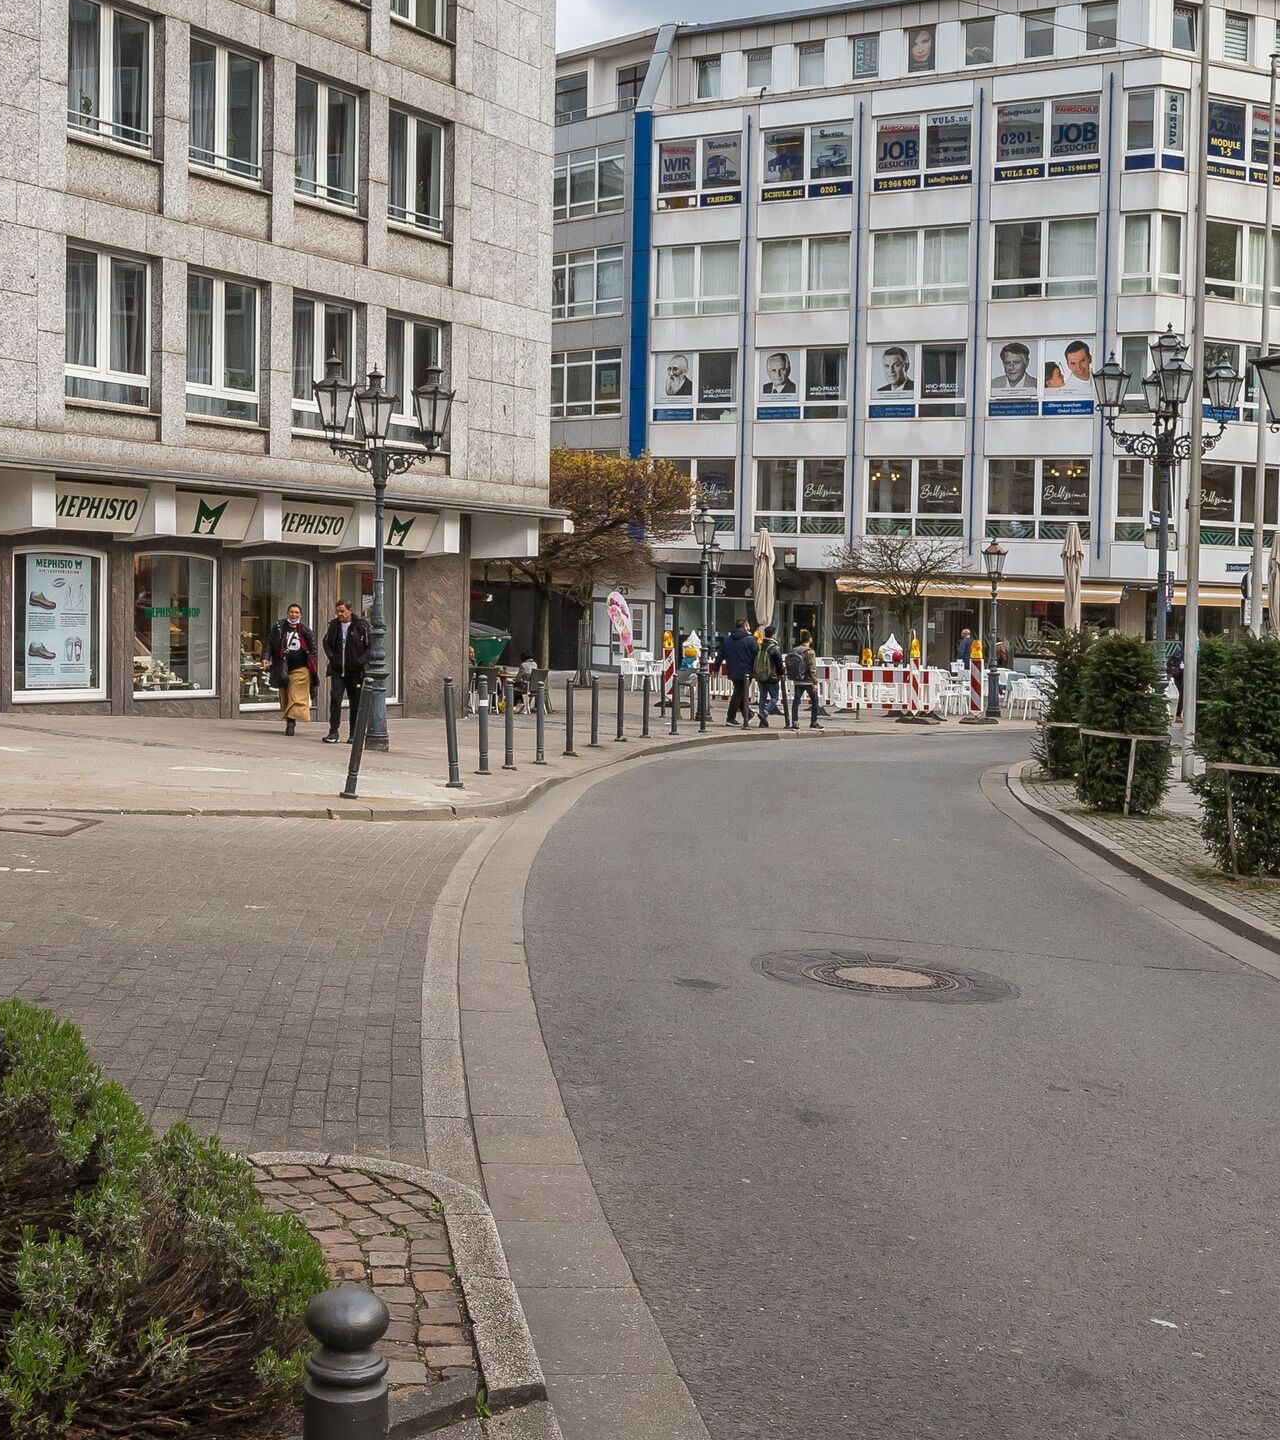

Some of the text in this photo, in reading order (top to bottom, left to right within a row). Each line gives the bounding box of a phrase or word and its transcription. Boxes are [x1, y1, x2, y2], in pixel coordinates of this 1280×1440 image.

[1169, 95, 1178, 145] VULS.DE
[1053, 122, 1097, 145] JOB
[1053, 142, 1097, 153] GESUCHT?
[1210, 138, 1241, 150] MODULE
[878, 139, 918, 162] JOB
[1220, 147, 1232, 156] 1-5
[664, 157, 691, 172] WIR
[663, 172, 691, 182] BILDEN
[1001, 167, 1039, 177] VULS.DE
[706, 194, 736, 203] FAHRER-
[764, 189, 803, 199] SCHULE.DE
[804, 483, 842, 497] Bellissima
[920, 484, 960, 499] Bellissima
[1043, 485, 1087, 500] Bellissima
[56, 494, 139, 521] MEPHISTO
[36, 558, 73, 570] MEPHISTO
[619, 587, 629, 595] 23
